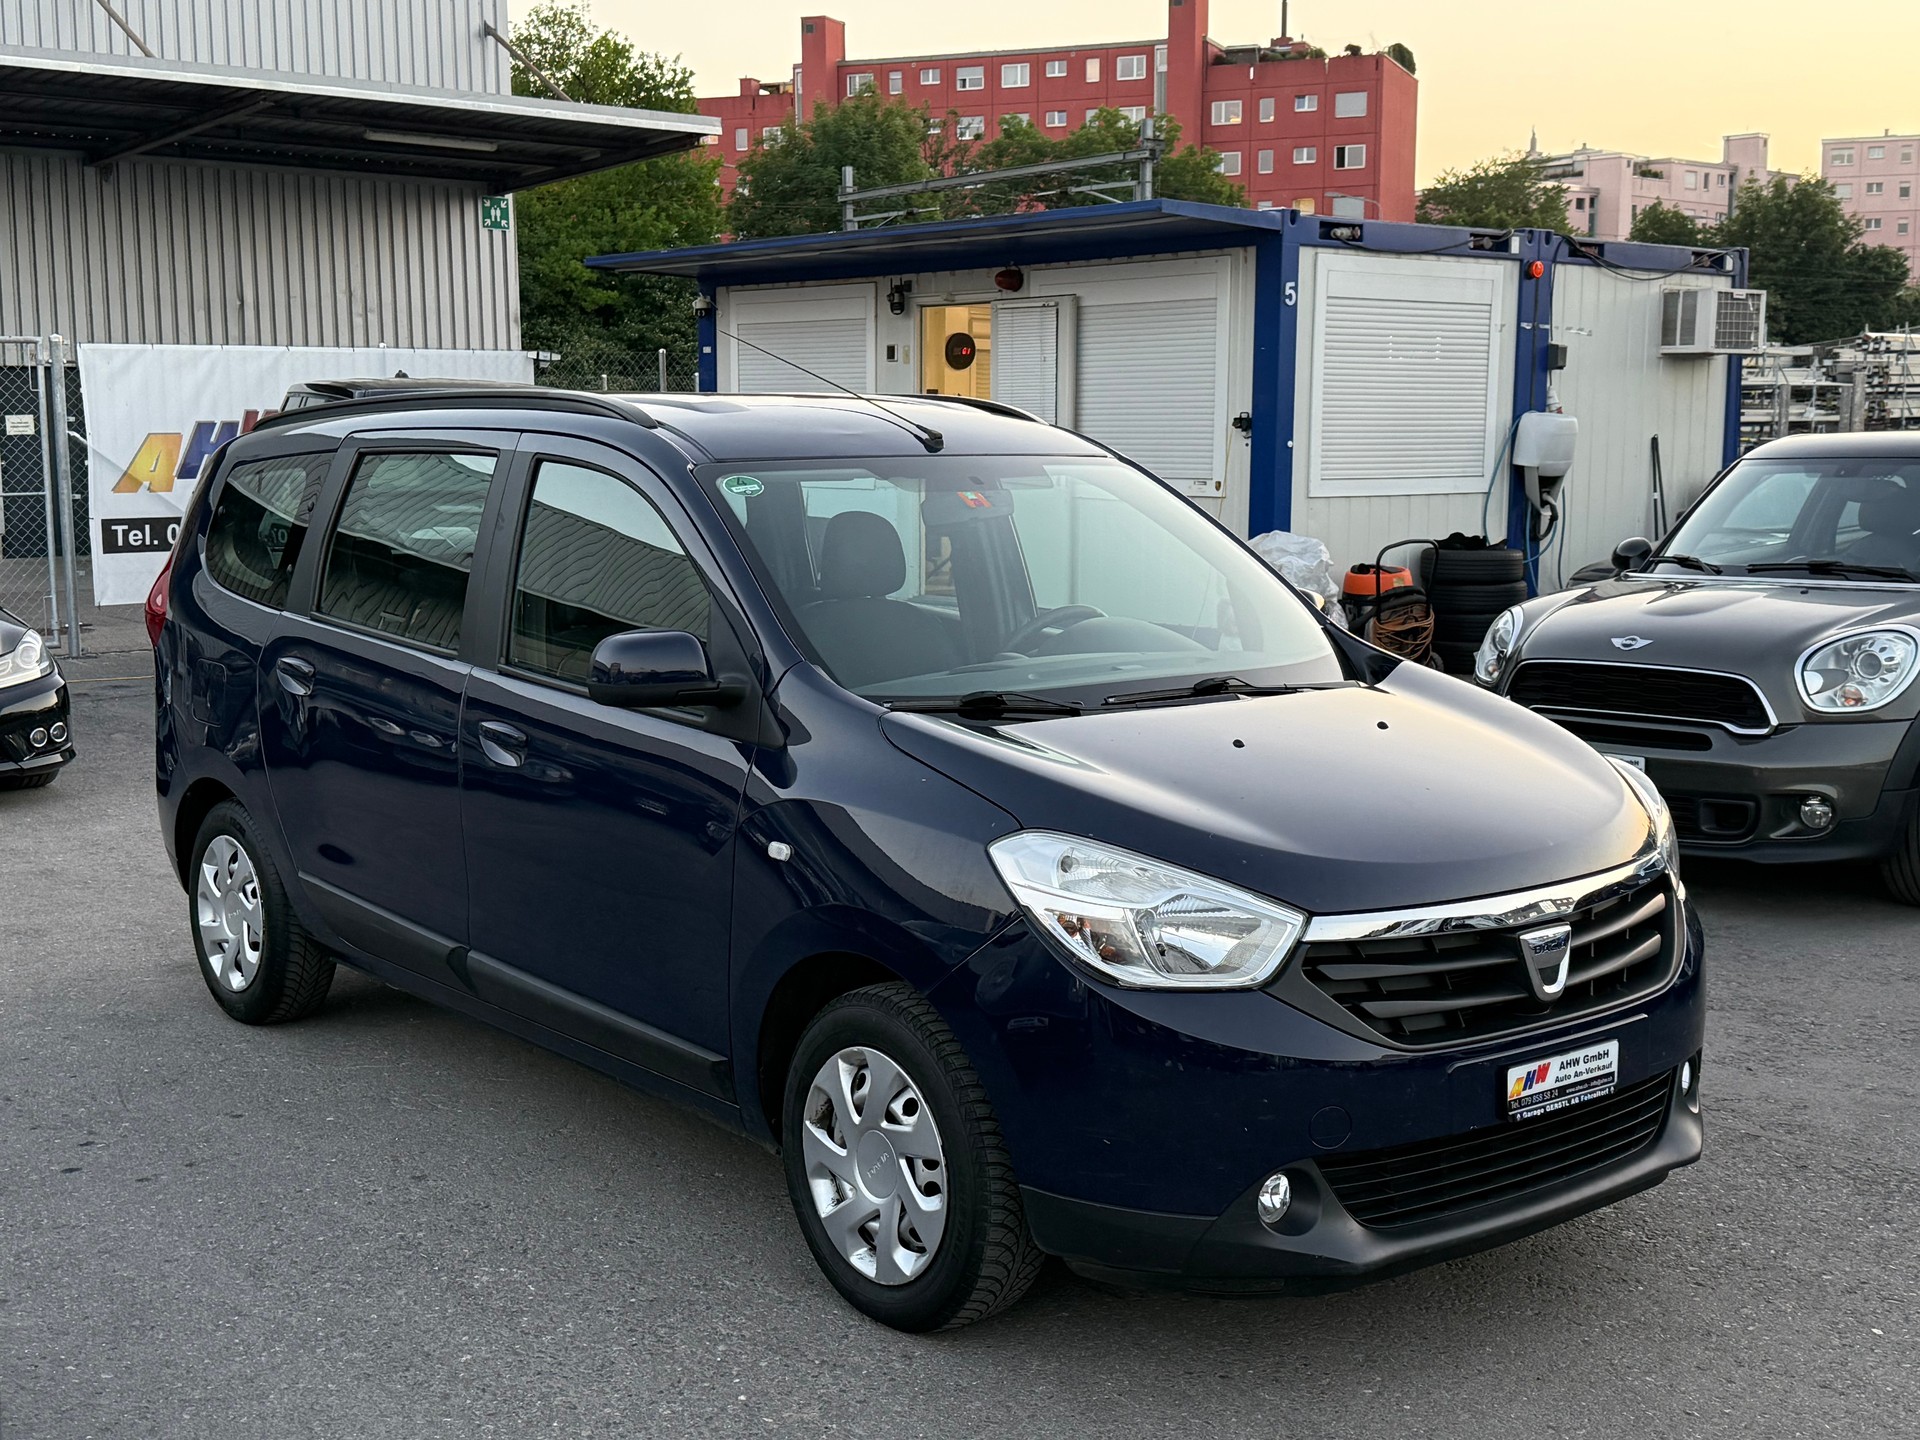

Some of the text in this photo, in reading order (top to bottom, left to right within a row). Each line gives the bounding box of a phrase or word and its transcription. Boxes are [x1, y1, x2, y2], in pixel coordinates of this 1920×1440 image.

[1285, 281, 1296, 306] 5
[111, 409, 279, 493] AH
[111, 524, 158, 547] Tel.
[1559, 1049, 1609, 1071] AHW GmbH
[1508, 1062, 1551, 1099] AHW
[1554, 1061, 1613, 1084] Auto An-Verkauf
[1523, 1108, 1544, 1118] Garage
[1545, 1100, 1570, 1112] GERSTL
[1571, 1096, 1580, 1105] AG
